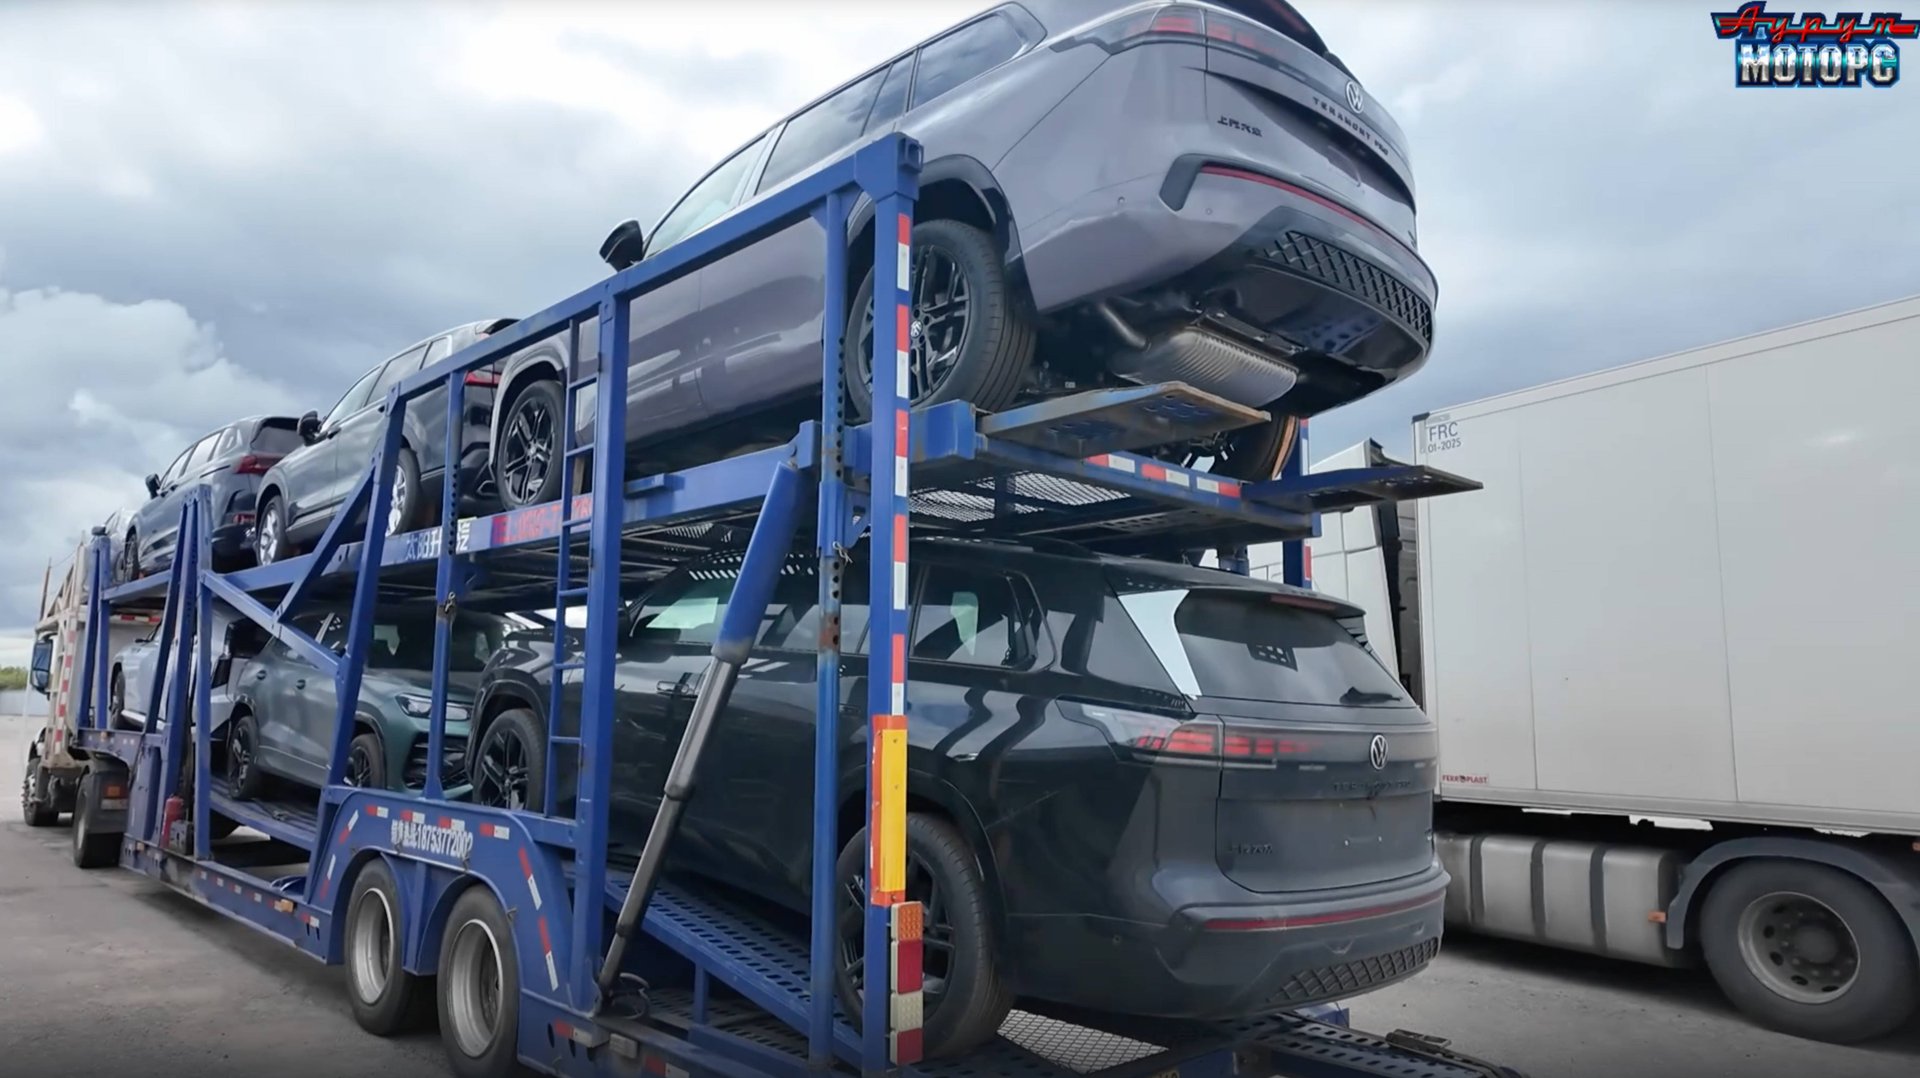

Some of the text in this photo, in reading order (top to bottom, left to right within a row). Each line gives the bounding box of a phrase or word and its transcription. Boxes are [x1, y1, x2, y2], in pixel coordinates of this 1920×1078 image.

[1312, 96, 1371, 140] TERAMONT
[1429, 421, 1458, 442] FRC
[1427, 437, 1462, 453] 01-2025
